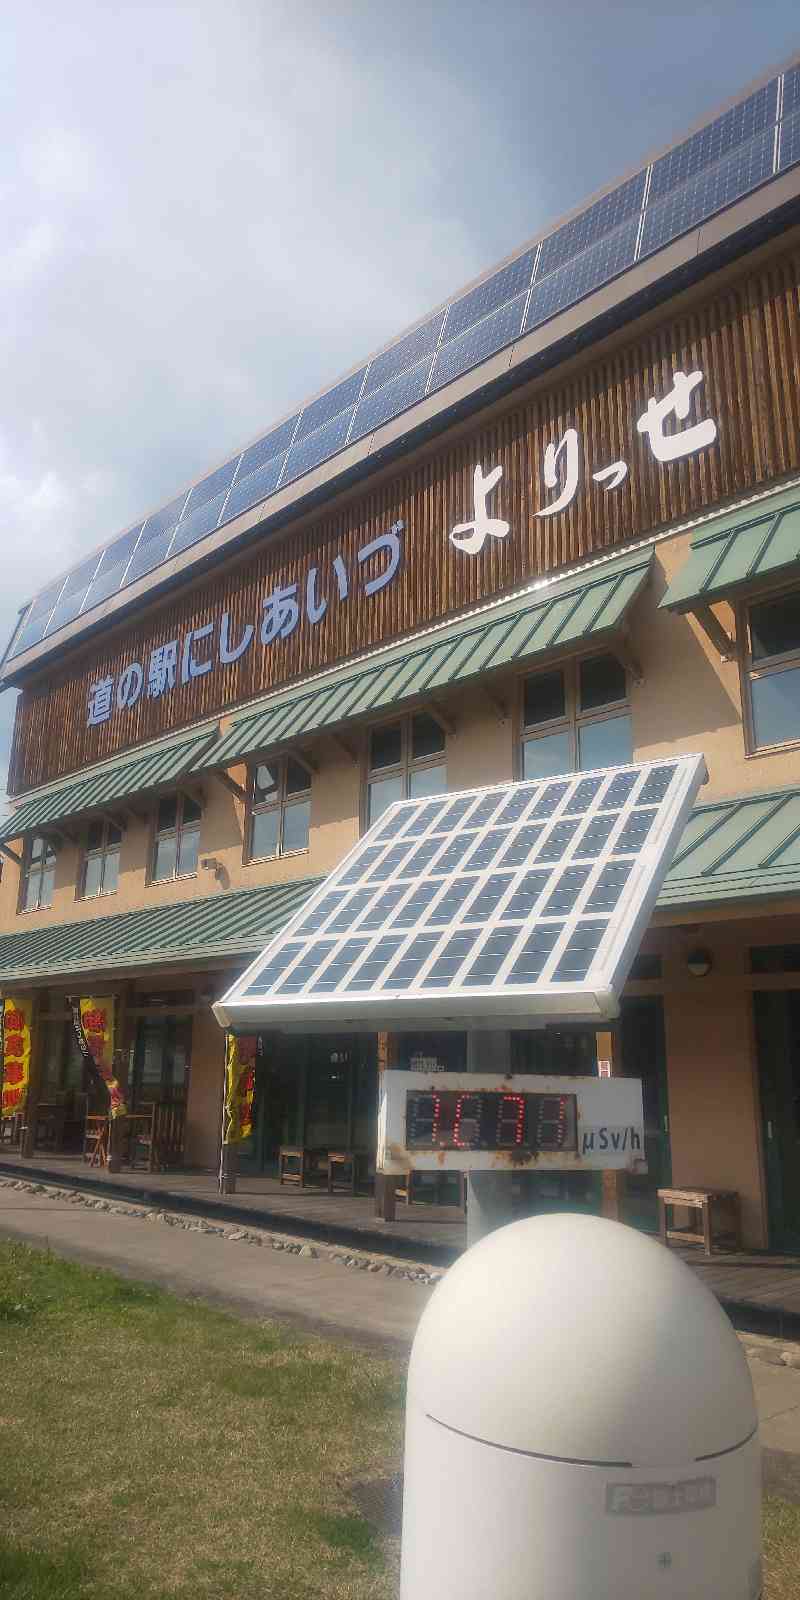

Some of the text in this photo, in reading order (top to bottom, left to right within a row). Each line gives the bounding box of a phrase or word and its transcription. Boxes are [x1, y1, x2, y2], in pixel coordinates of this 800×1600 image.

[449, 370, 717, 556] よりっせ
[86, 519, 405, 728] 道の駅にしあいづ
